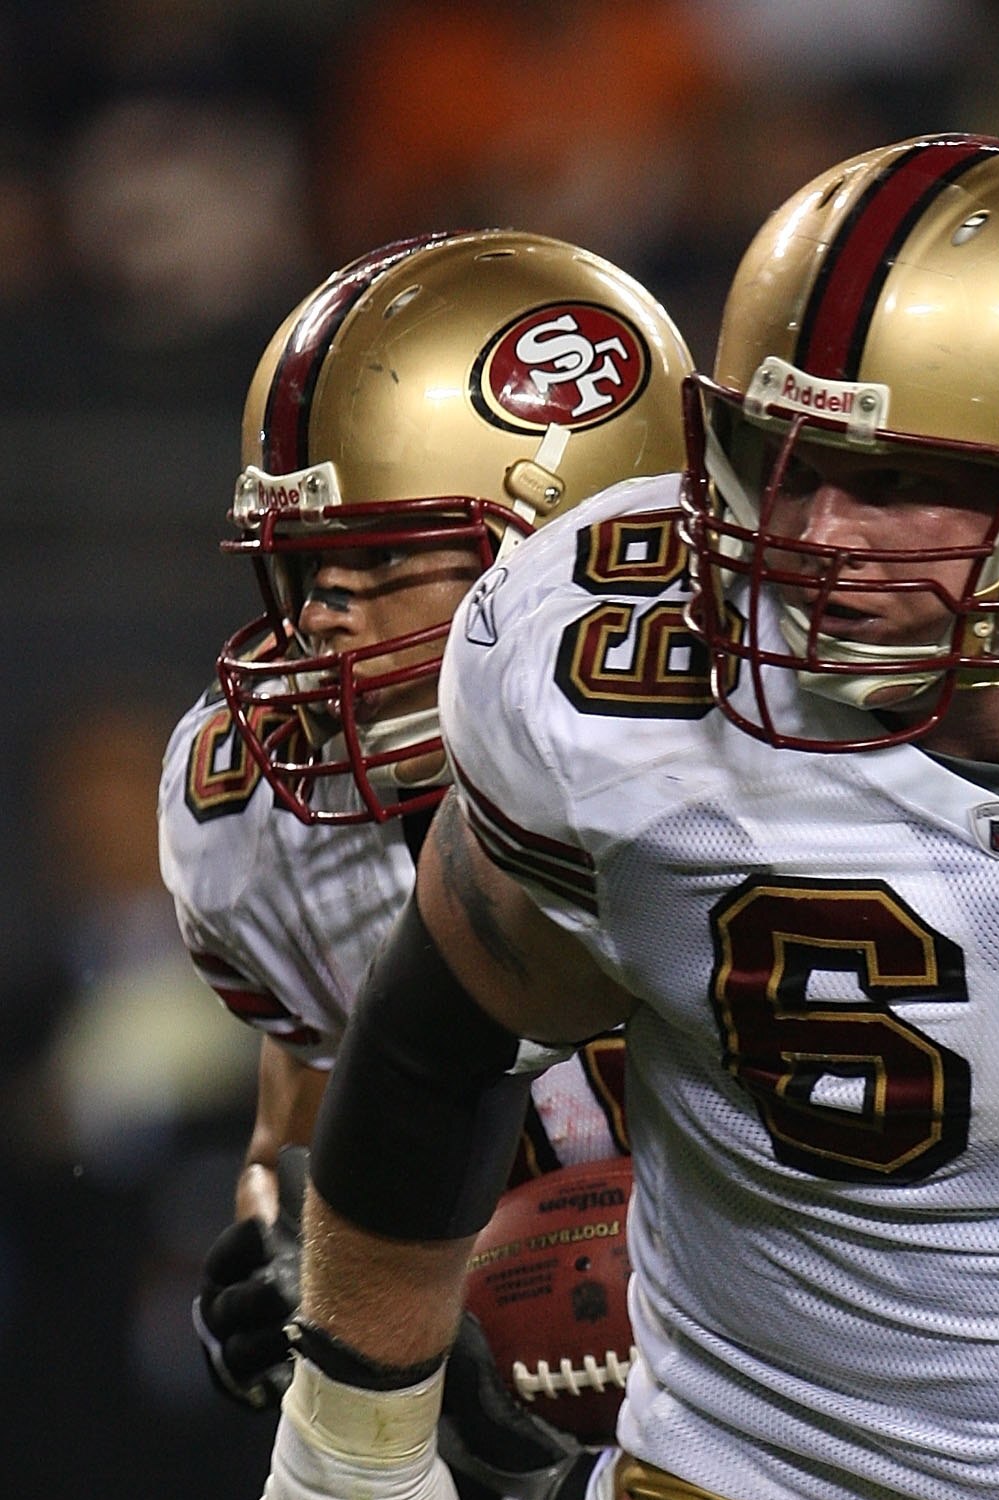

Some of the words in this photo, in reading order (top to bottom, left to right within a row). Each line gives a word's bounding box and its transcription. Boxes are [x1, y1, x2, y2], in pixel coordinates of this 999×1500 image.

[515, 314, 629, 418] SF
[782, 373, 855, 413] Riddell
[526, 1219, 621, 1252] FOOTBALL
